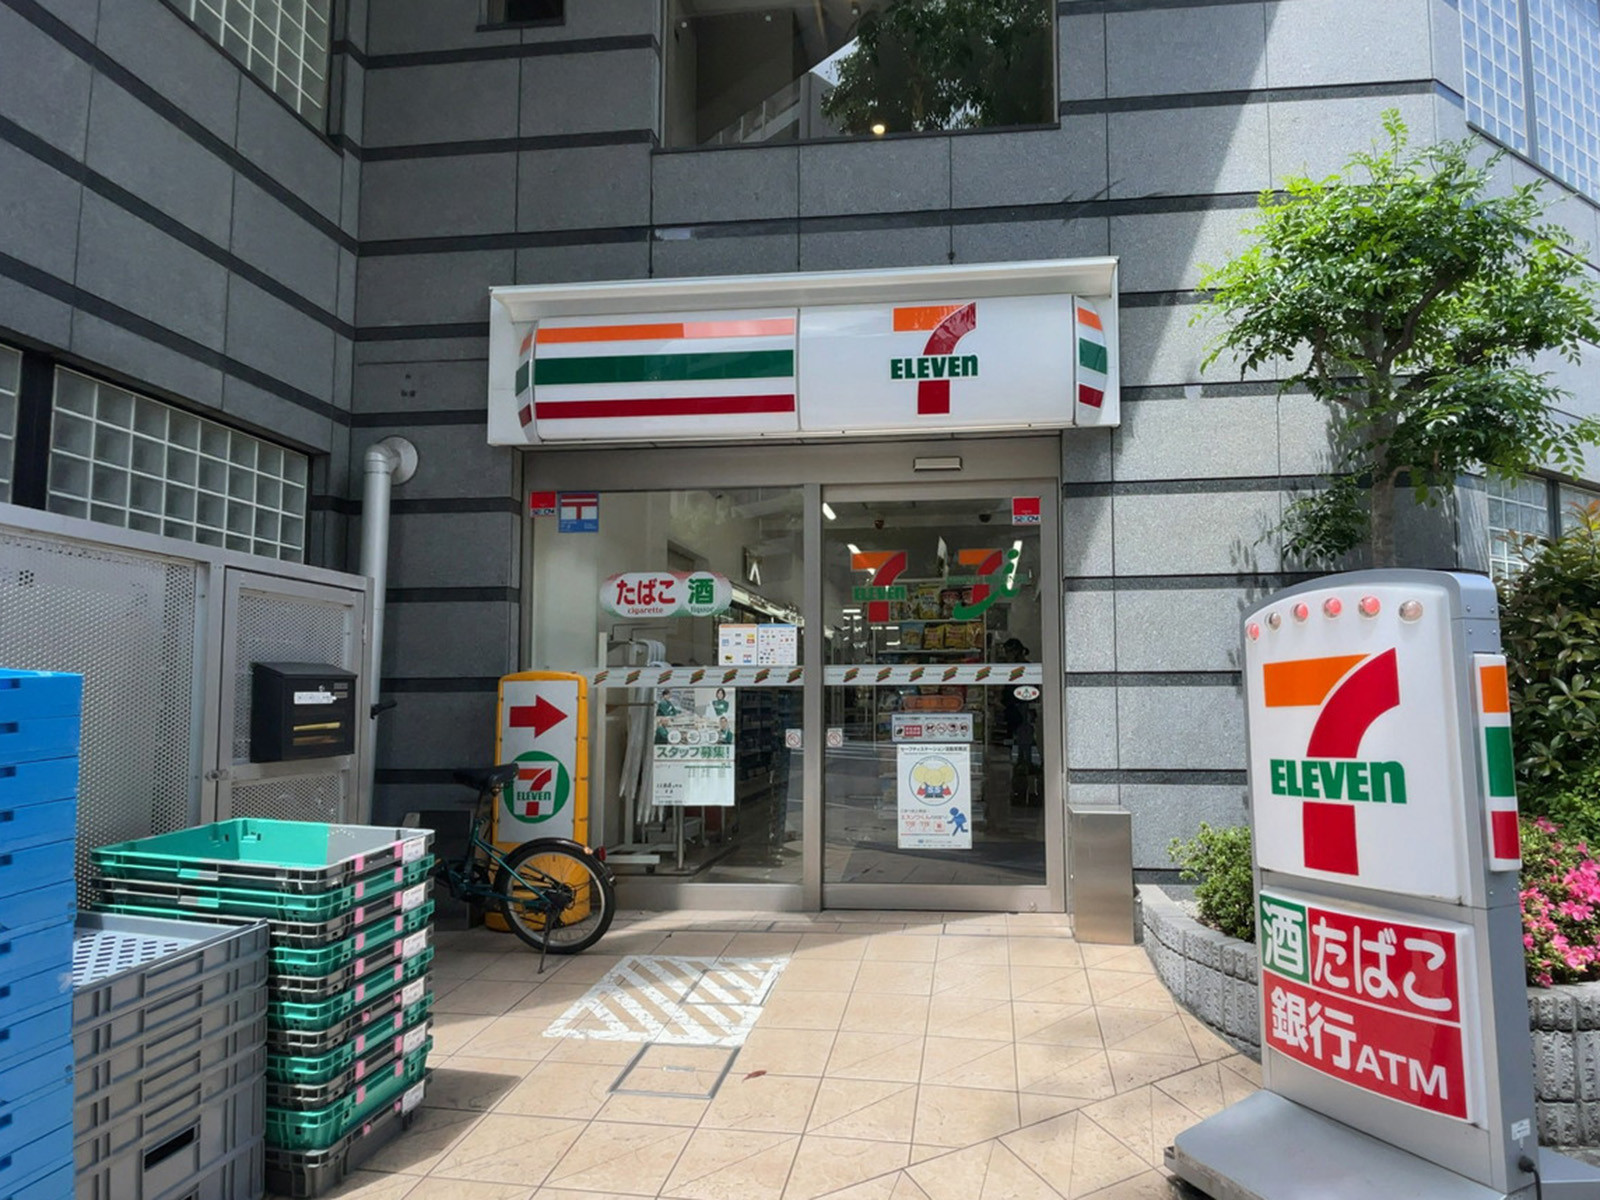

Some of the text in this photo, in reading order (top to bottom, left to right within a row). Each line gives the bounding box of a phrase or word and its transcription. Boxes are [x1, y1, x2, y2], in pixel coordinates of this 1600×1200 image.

[893, 302, 977, 415] 7
[616, 578, 676, 606] たばこ
[627, 606, 664, 615] cigarette
[688, 578, 714, 605] 酒
[1262, 648, 1400, 876] 7
[517, 768, 552, 816] 7
[1262, 904, 1452, 1012] 酒 たばこ
